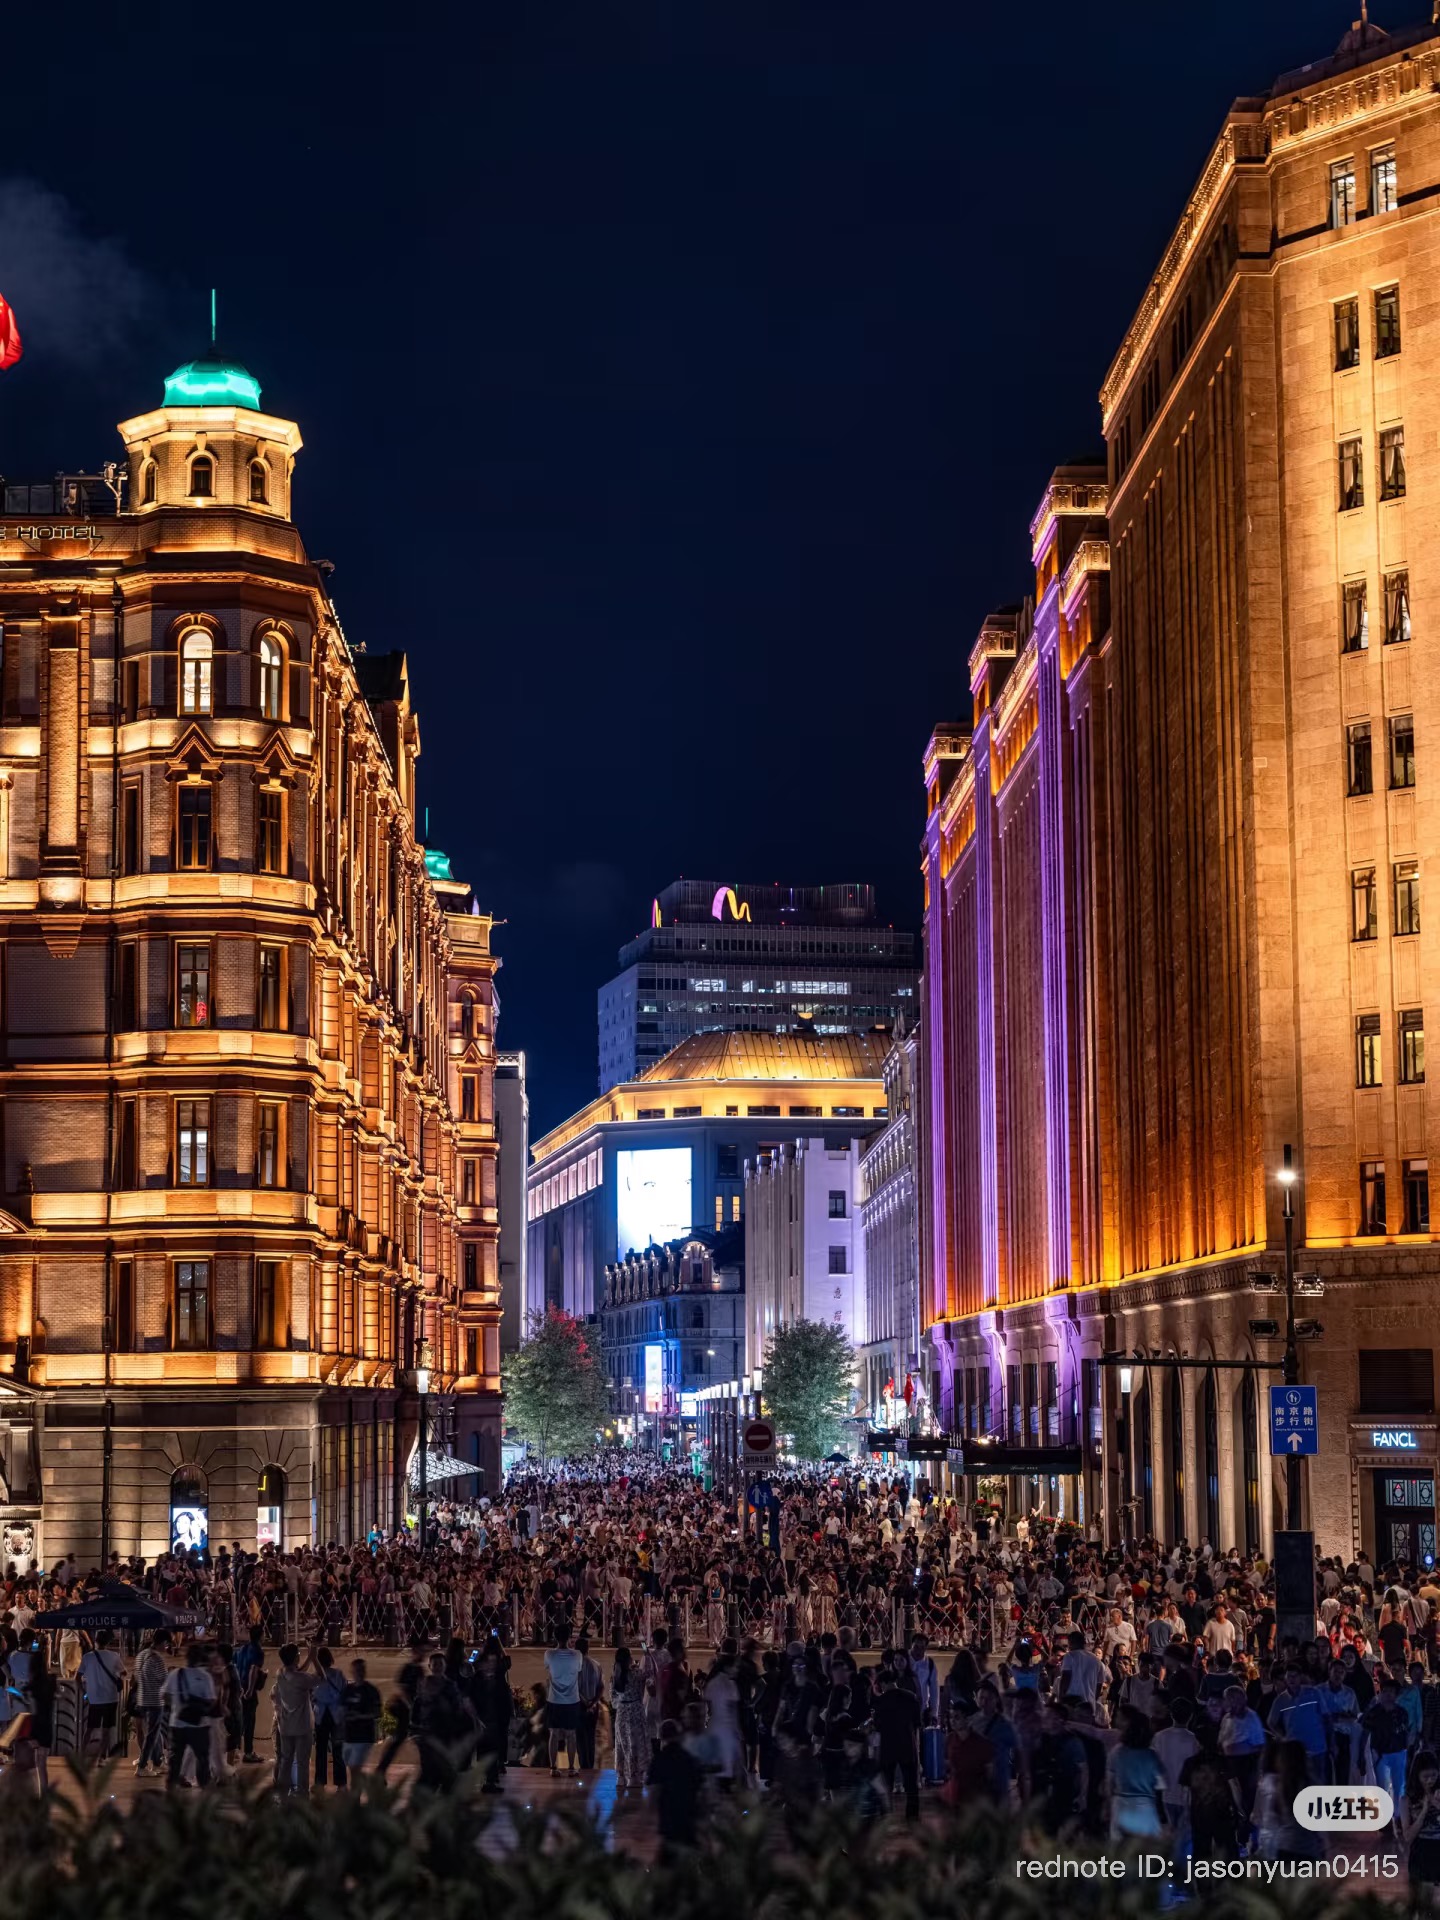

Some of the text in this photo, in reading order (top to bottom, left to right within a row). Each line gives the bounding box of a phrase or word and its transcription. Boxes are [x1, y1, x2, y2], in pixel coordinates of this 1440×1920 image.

[17, 526, 104, 540] HOTEL
[1275, 1407, 1313, 1416] 南京路
[1275, 1417, 1313, 1426] 步行街
[1373, 1432, 1416, 1447] FANCL
[80, 1616, 117, 1626] POLICE
